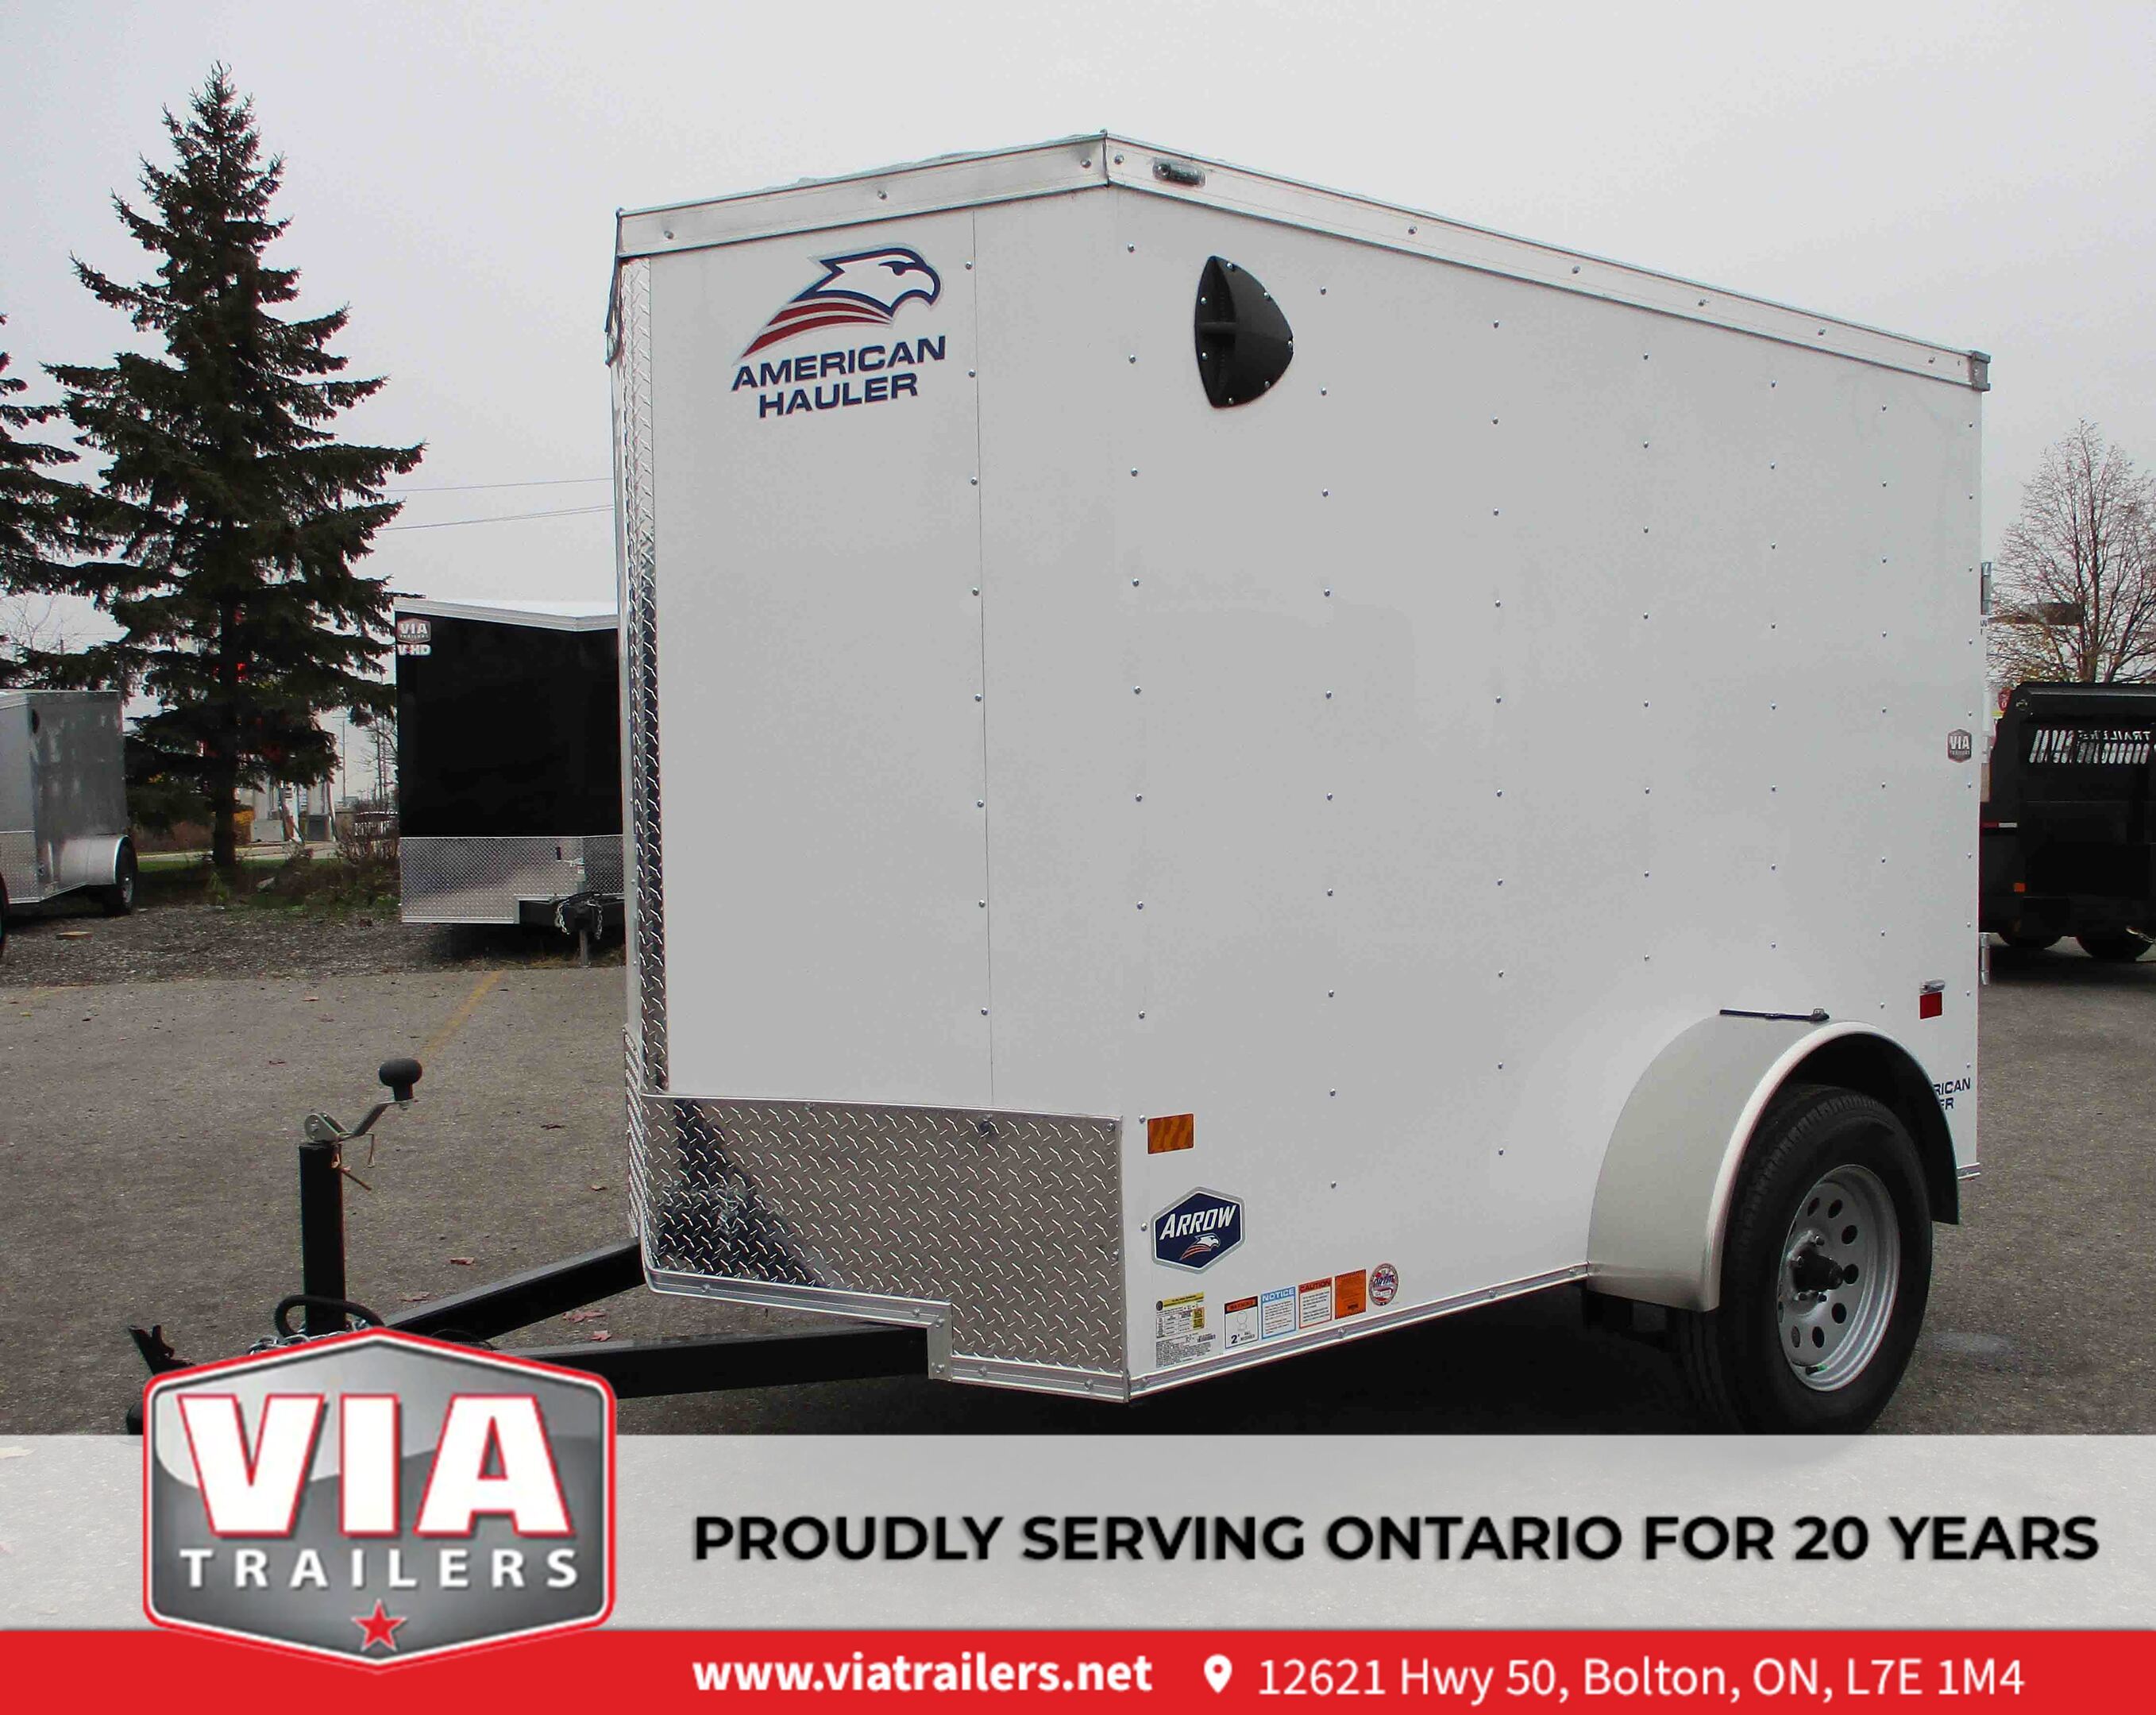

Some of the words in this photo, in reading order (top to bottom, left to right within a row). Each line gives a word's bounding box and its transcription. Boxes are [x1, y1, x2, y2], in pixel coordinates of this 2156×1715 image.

[731, 335, 946, 391] AMERICAN
[759, 372, 918, 418] HAULER
[399, 622, 428, 634] VIA
[1950, 735, 1969, 750] VIA
[1934, 1077, 1970, 1095] RICAN
[1159, 1204, 1236, 1240] ARROW
[1299, 1280, 1331, 1292] CAUTION
[1262, 1288, 1294, 1302] NOTICE
